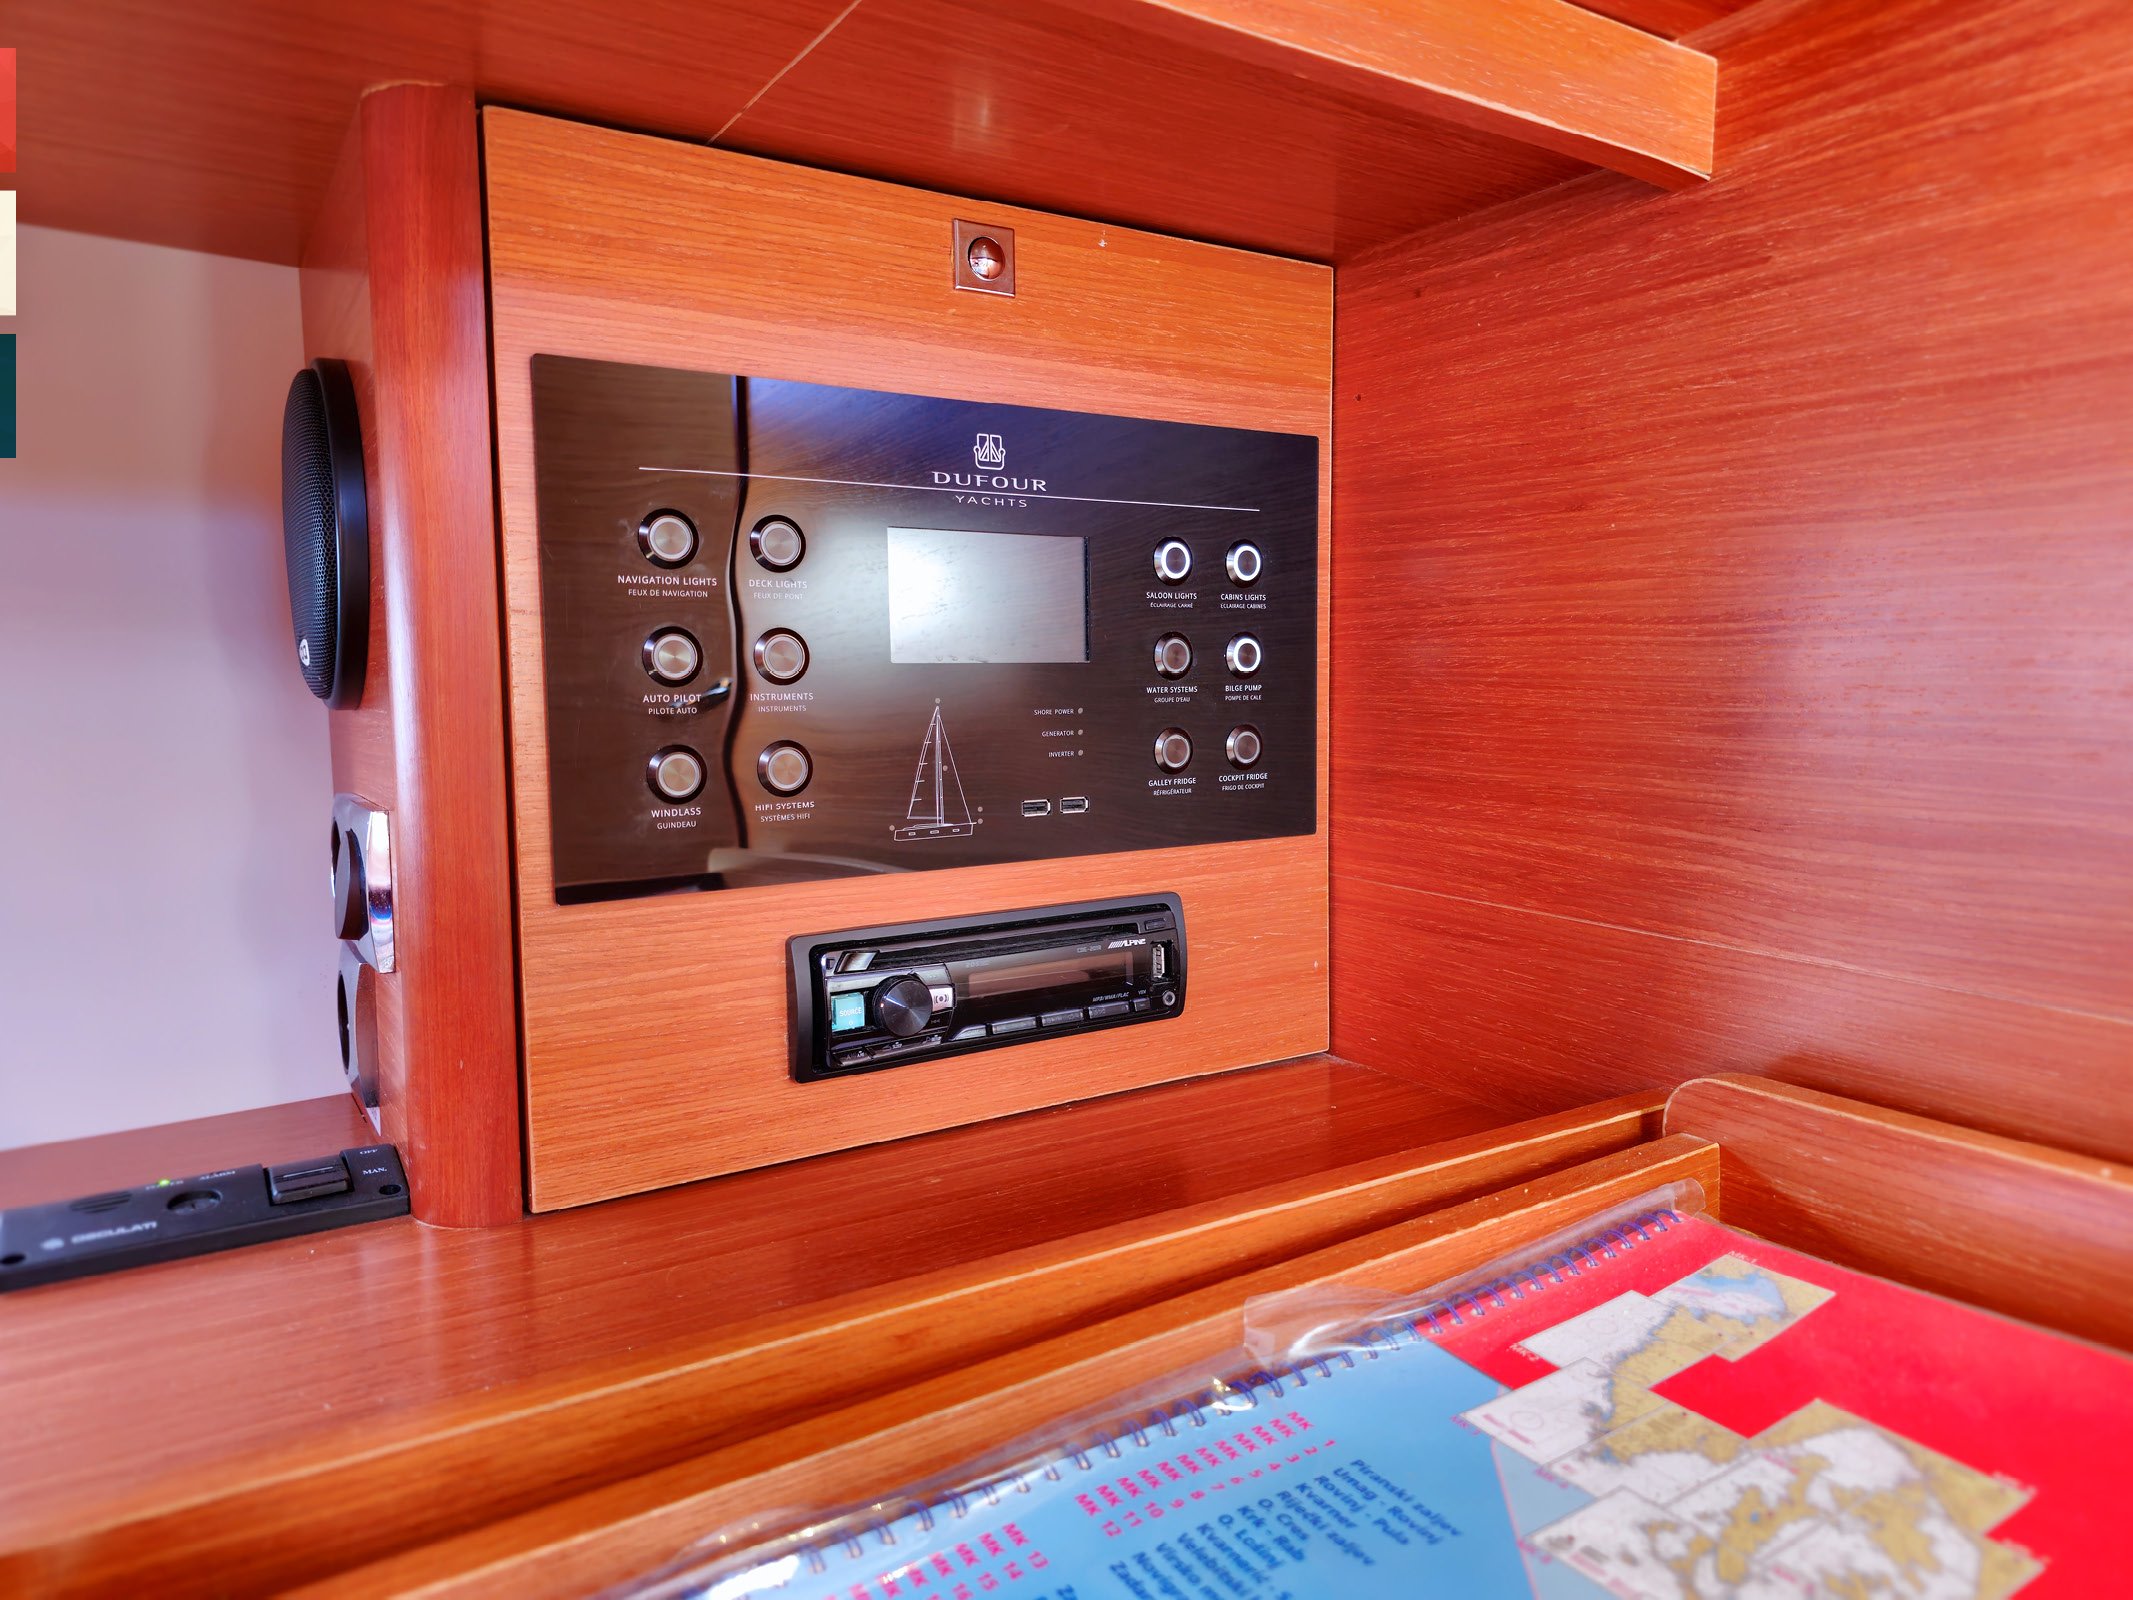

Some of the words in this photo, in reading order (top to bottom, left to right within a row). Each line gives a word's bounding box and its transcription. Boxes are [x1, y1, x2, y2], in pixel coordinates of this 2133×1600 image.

[932, 471, 1047, 492] DUFOUR
[955, 495, 1027, 508] YACHTS
[618, 575, 680, 585] NAVIGATION
[683, 577, 718, 586] LIGHTS
[749, 579, 773, 588] DECK
[776, 580, 808, 589] LIGHTS
[628, 588, 648, 596] FEUX
[662, 590, 708, 598] NAVIGATION
[754, 592, 771, 600] FEUX
[773, 592, 783, 600] DE
[1174, 592, 1198, 600] LIGHTS
[1146, 686, 1168, 694] WATER
[643, 694, 670, 703] AUTO
[674, 694, 702, 703] PILOT
[750, 692, 814, 701] INSTRUMENTS
[648, 707, 675, 715] PILOTE
[676, 707, 698, 715] AUTO
[758, 705, 807, 713] INSTRUMENTS
[1048, 750, 1074, 758] INVERTER
[1218, 774, 1245, 782] COCKPIT
[1246, 772, 1268, 780] FRIDGE
[1148, 779, 1172, 787] GALLEY
[1153, 788, 1192, 796] RÉFRIGÉRATEUR
[755, 804, 773, 812] HIFI
[776, 801, 815, 810] SYSTEMS
[650, 807, 701, 818] WINDLASS
[760, 813, 796, 822] SYSTÈMES
[656, 820, 697, 830] GUINDEAU
[1115, 939, 1146, 948] ALPINE
[840, 1006, 862, 1016] SOURCE
[363, 1167, 388, 1175] MAN.
[1288, 1411, 1314, 1431] MK
[1251, 1425, 1279, 1445] MK
[1285, 1454, 1301, 1463] 3
[1232, 1433, 1261, 1453] MK
[1268, 1462, 1282, 1471] 4
[1213, 1440, 1242, 1461] MK
[1249, 1468, 1264, 1478] 5
[1269, 1418, 1297, 1438] MK
[1303, 1446, 1318, 1456] 2
[1332, 1467, 1378, 1501] Umag
[1195, 1447, 1222, 1467] MK
[1229, 1476, 1245, 1485] 6
[1156, 1461, 1184, 1481] MK
[1189, 1490, 1206, 1500] 8
[1136, 1469, 1164, 1489] MK
[1170, 1499, 1185, 1508] 9
[1176, 1454, 1203, 1474] MK
[1210, 1483, 1226, 1491] 7
[1237, 1505, 1266, 1528] Krk
[1116, 1477, 1144, 1498] MK
[1144, 1501, 1165, 1519] 10
[1096, 1485, 1124, 1507] MK
[1123, 1511, 1144, 1528] 11
[1074, 1493, 1102, 1517] MK
[1102, 1520, 1122, 1537] 12
[1003, 1521, 1030, 1547] MK
[954, 1542, 981, 1567] MK
[978, 1532, 1005, 1557] MK
[1002, 1560, 1025, 1581] 14
[928, 1552, 955, 1578] MK
